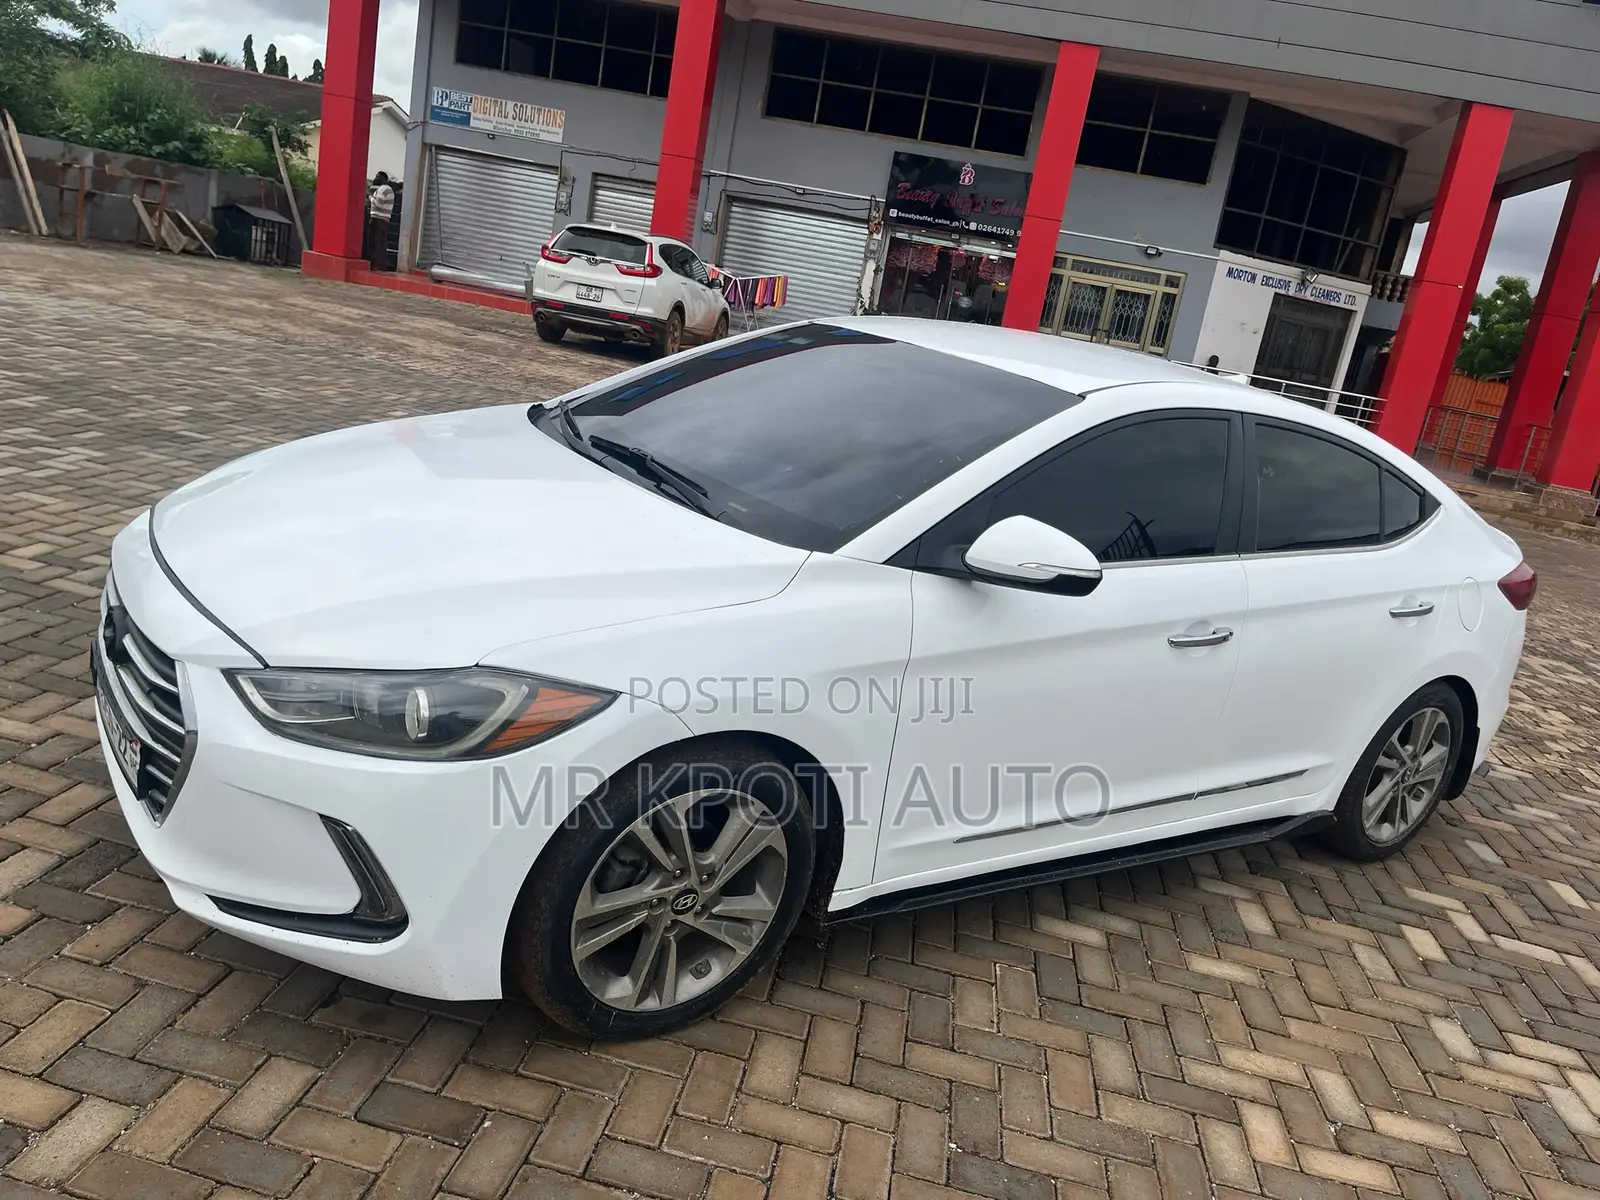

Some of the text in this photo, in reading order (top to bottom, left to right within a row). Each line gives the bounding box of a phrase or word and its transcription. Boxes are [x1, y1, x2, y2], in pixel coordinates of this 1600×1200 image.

[450, 91, 472, 103] BEST
[450, 100, 472, 111] PART
[472, 95, 509, 119] DIGITAL
[512, 103, 565, 130] SOLUTIONS
[1225, 266, 1258, 285] MORTON
[1260, 275, 1292, 292] EXCLUSIVE
[1295, 282, 1309, 295] DRY
[1310, 286, 1342, 303] CLEANERS
[1343, 294, 1357, 306] LTD.
